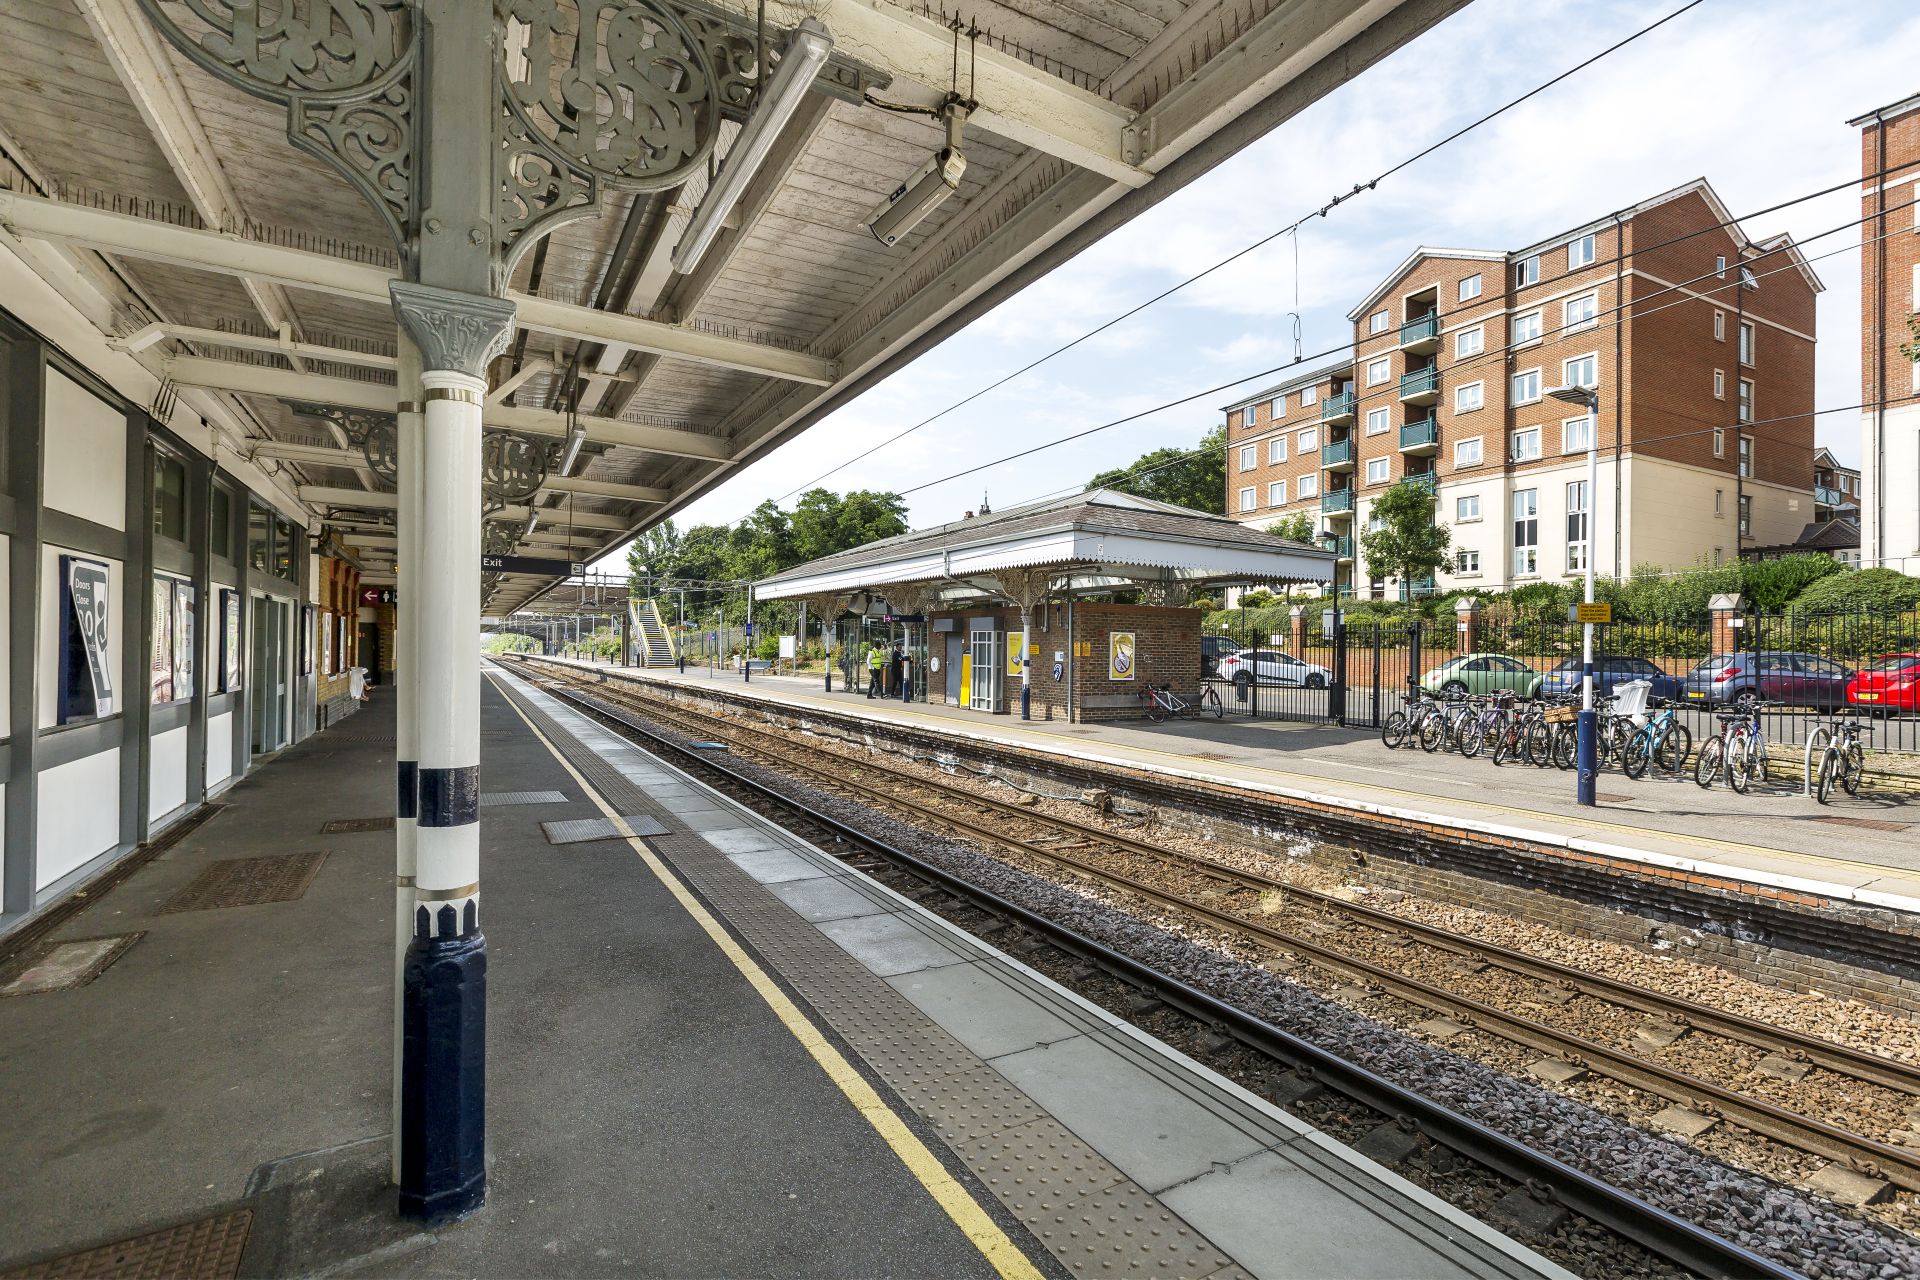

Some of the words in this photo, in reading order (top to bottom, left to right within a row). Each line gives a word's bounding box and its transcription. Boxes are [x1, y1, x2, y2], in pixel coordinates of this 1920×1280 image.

[483, 558, 503, 567] Exit
[75, 578, 91, 591] Doors
[75, 594, 90, 606] Close
